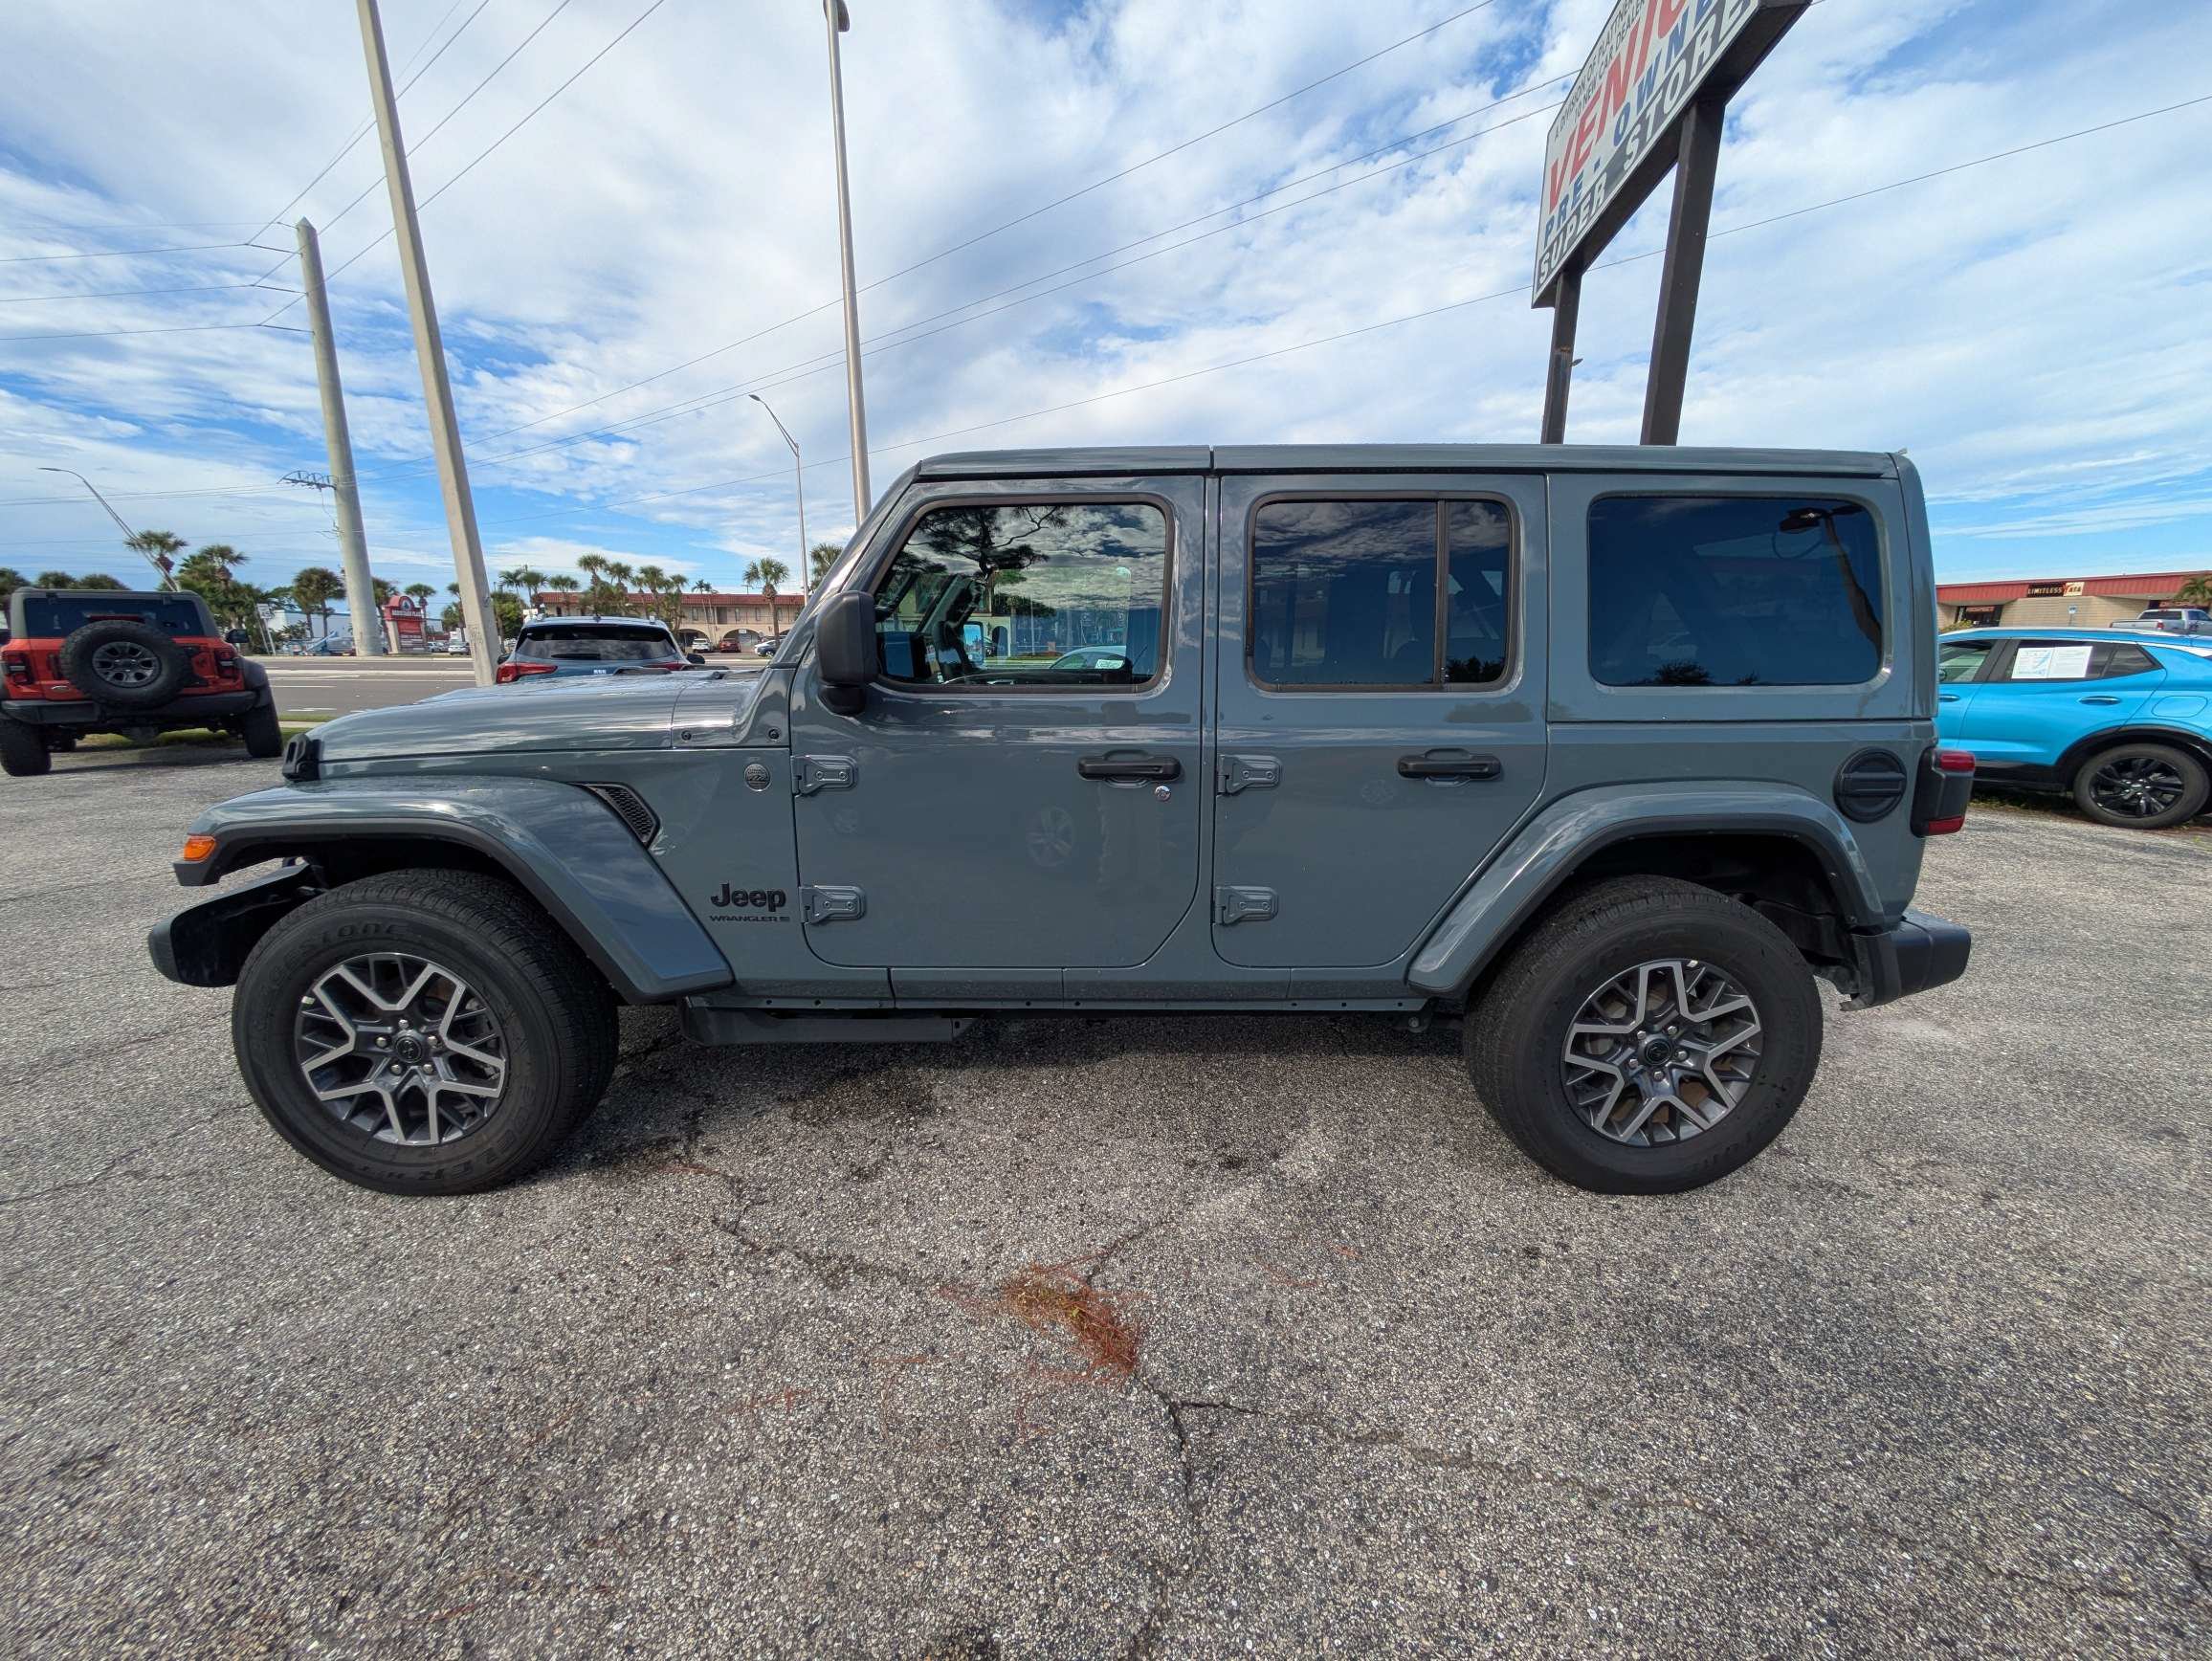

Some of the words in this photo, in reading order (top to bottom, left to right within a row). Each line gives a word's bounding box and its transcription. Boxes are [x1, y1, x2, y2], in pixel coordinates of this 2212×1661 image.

[1538, 171, 1607, 285] SUPER
[2027, 586, 2063, 595] LIMITLESS
[710, 882, 786, 912] Jeep
